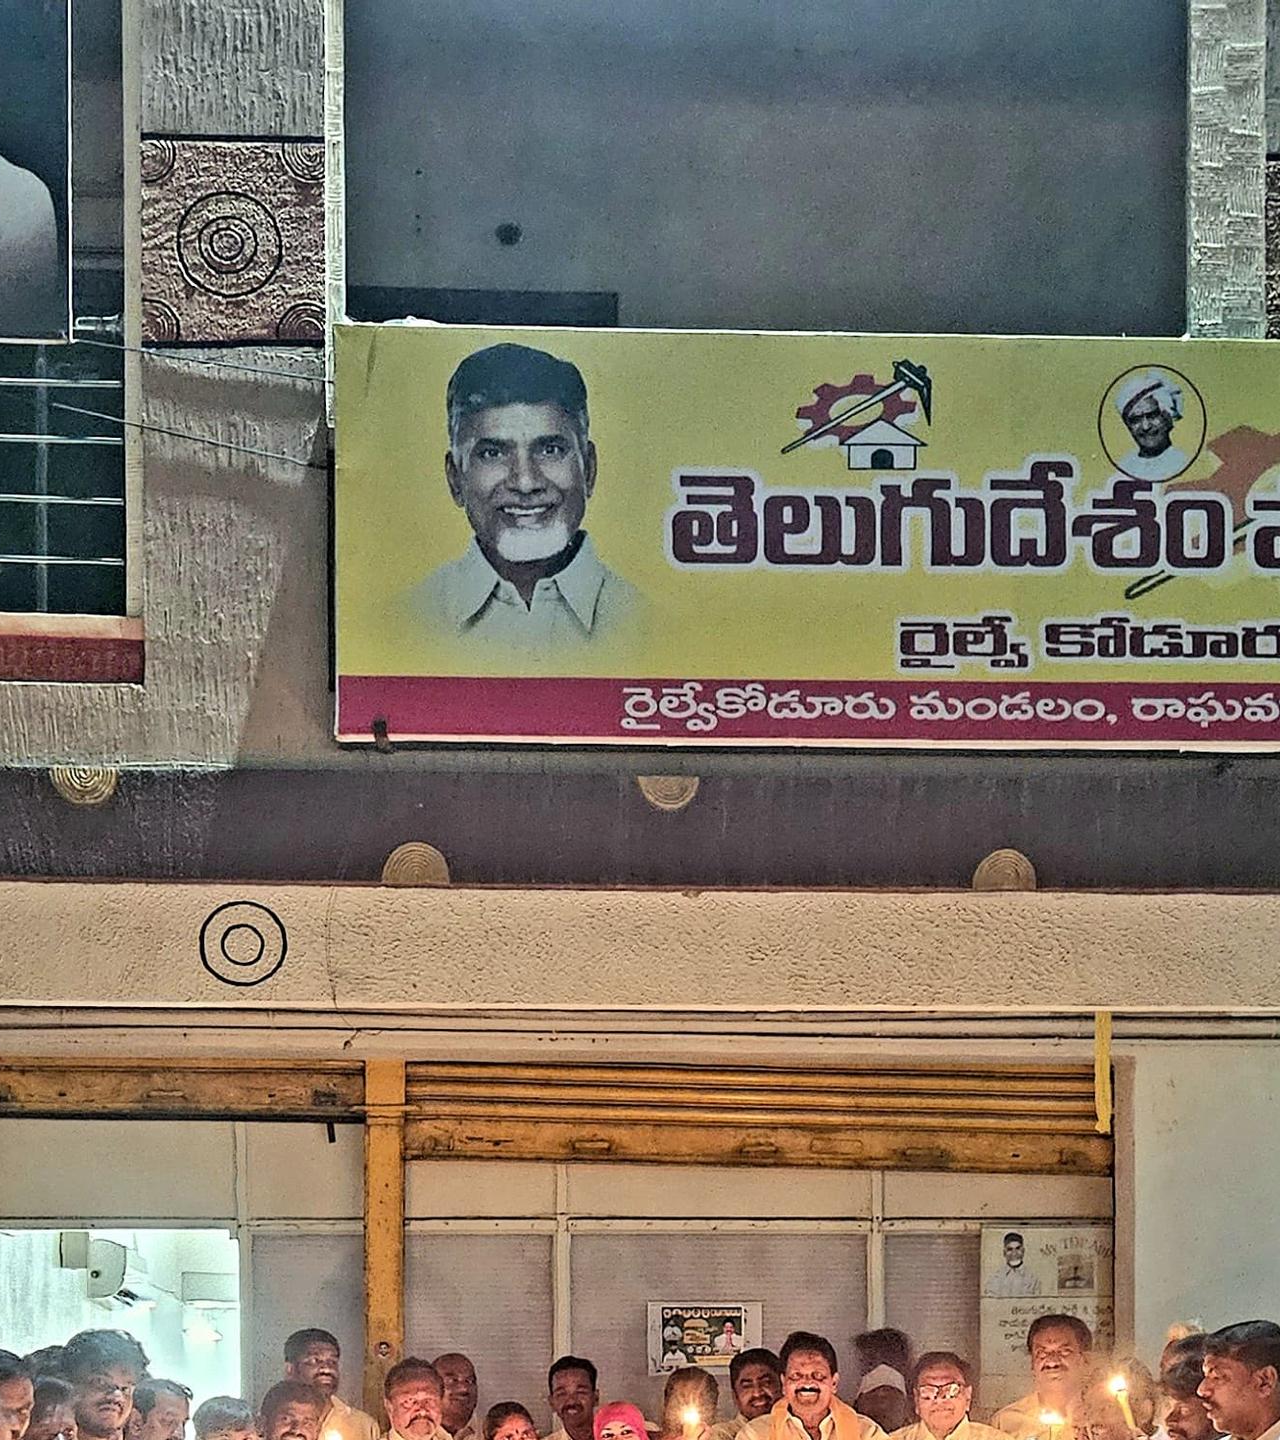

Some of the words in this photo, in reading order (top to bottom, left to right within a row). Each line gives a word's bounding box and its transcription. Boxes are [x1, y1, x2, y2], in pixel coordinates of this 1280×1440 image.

[671, 460, 1224, 569] తెలుగుదేశం
[899, 614, 1029, 669] రైల్వే
[621, 680, 897, 733] రైల్వేకోడూరు
[909, 691, 1118, 725] మండలం,
